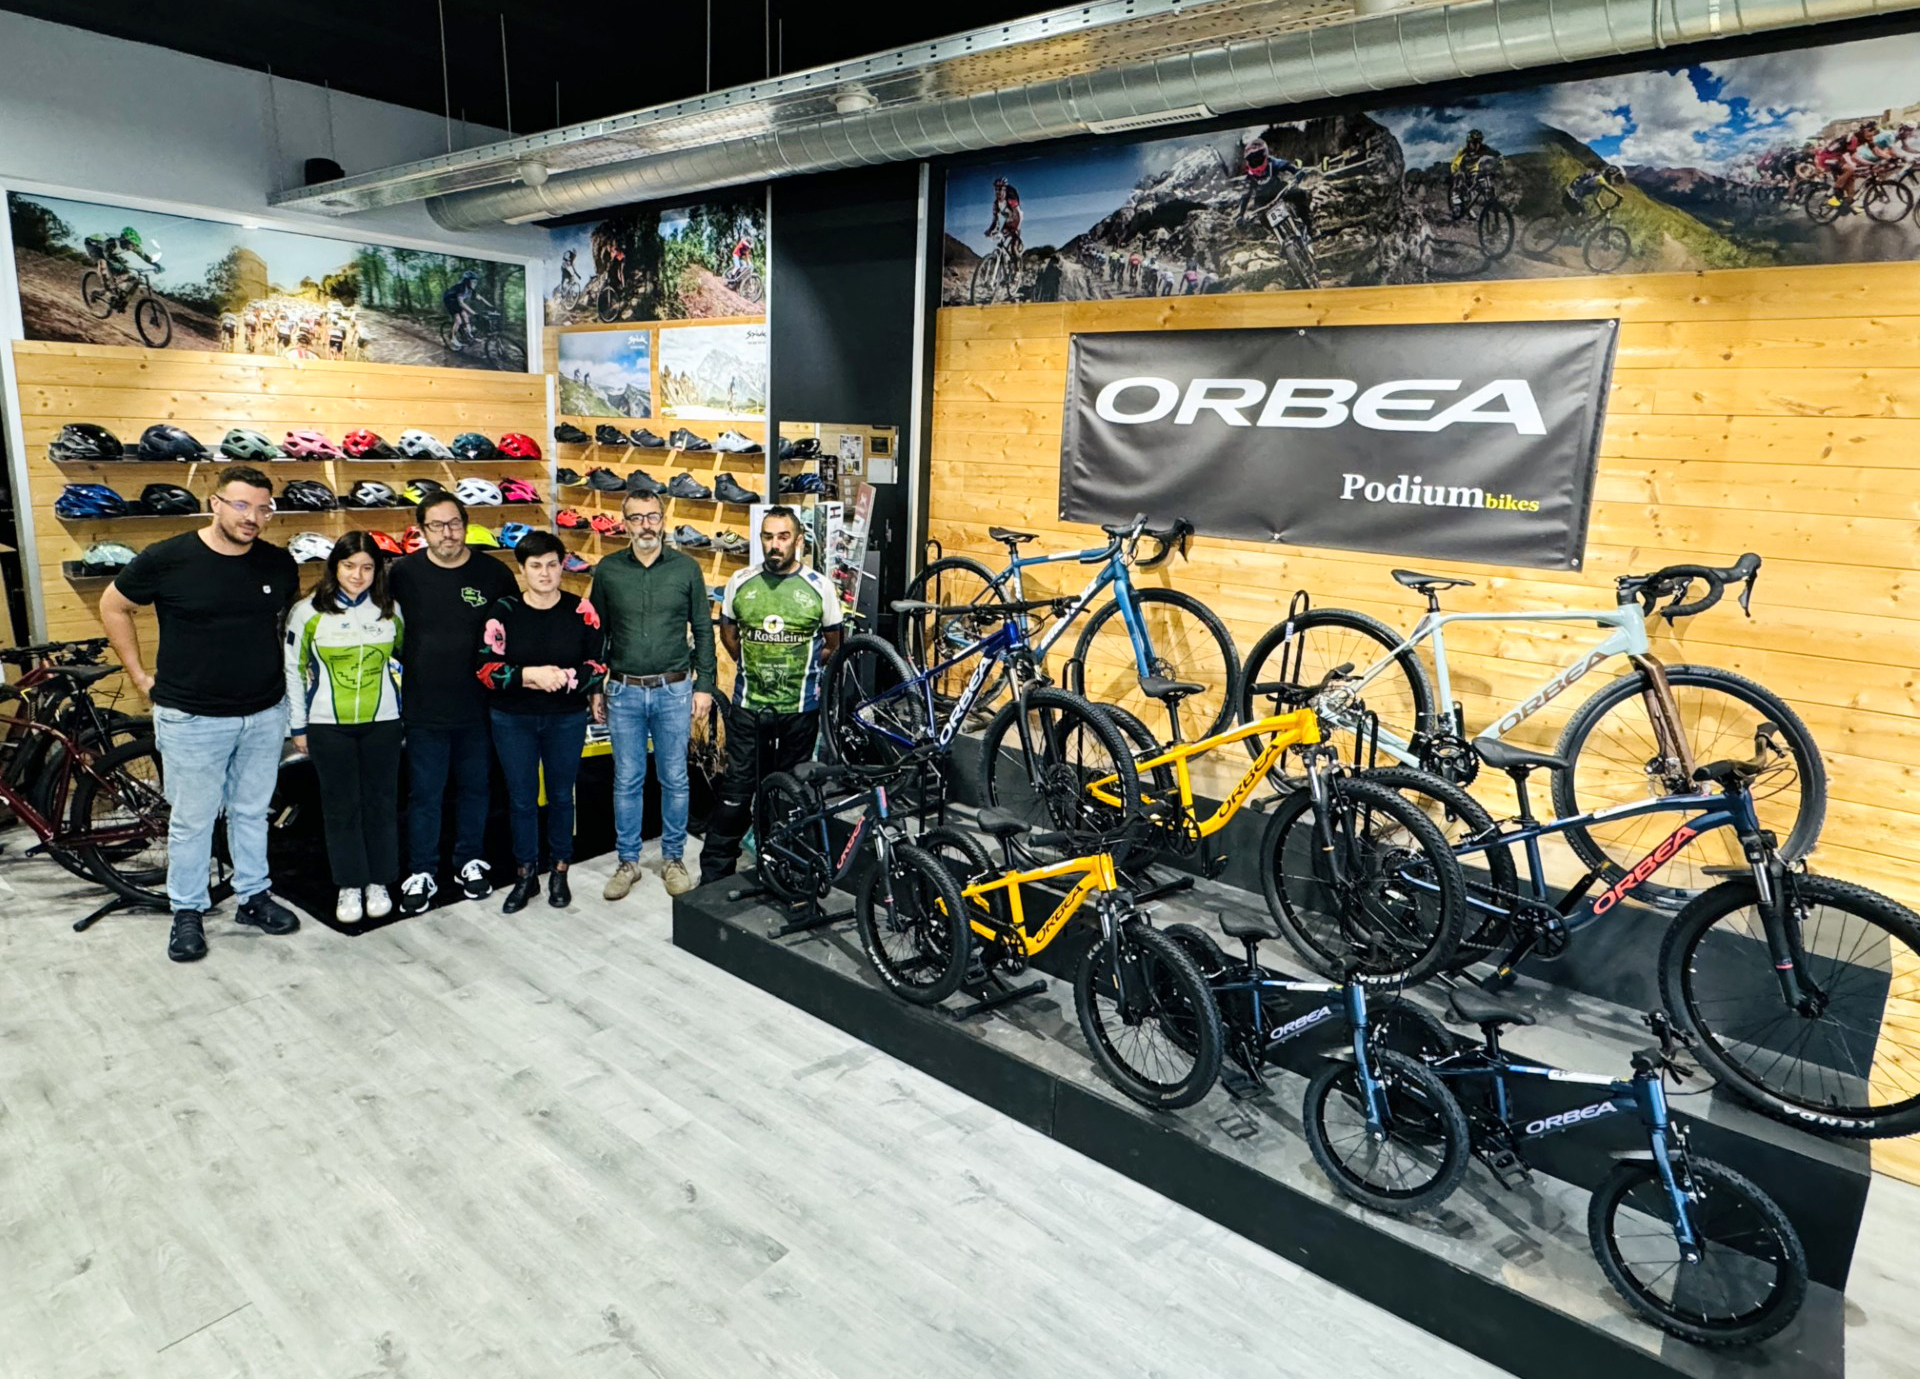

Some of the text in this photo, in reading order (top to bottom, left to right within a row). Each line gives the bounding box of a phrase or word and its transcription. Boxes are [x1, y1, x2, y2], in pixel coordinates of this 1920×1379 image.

[1096, 377, 1547, 435] ORBEA
[940, 657, 993, 745] ORBEA
[1499, 652, 1609, 735] ORBEA
[1593, 826, 1697, 915] ORBEA
[1270, 1006, 1332, 1039] ORBEA
[1526, 1101, 1618, 1134] ORBEA
[1783, 1105, 1875, 1128] KENDA
